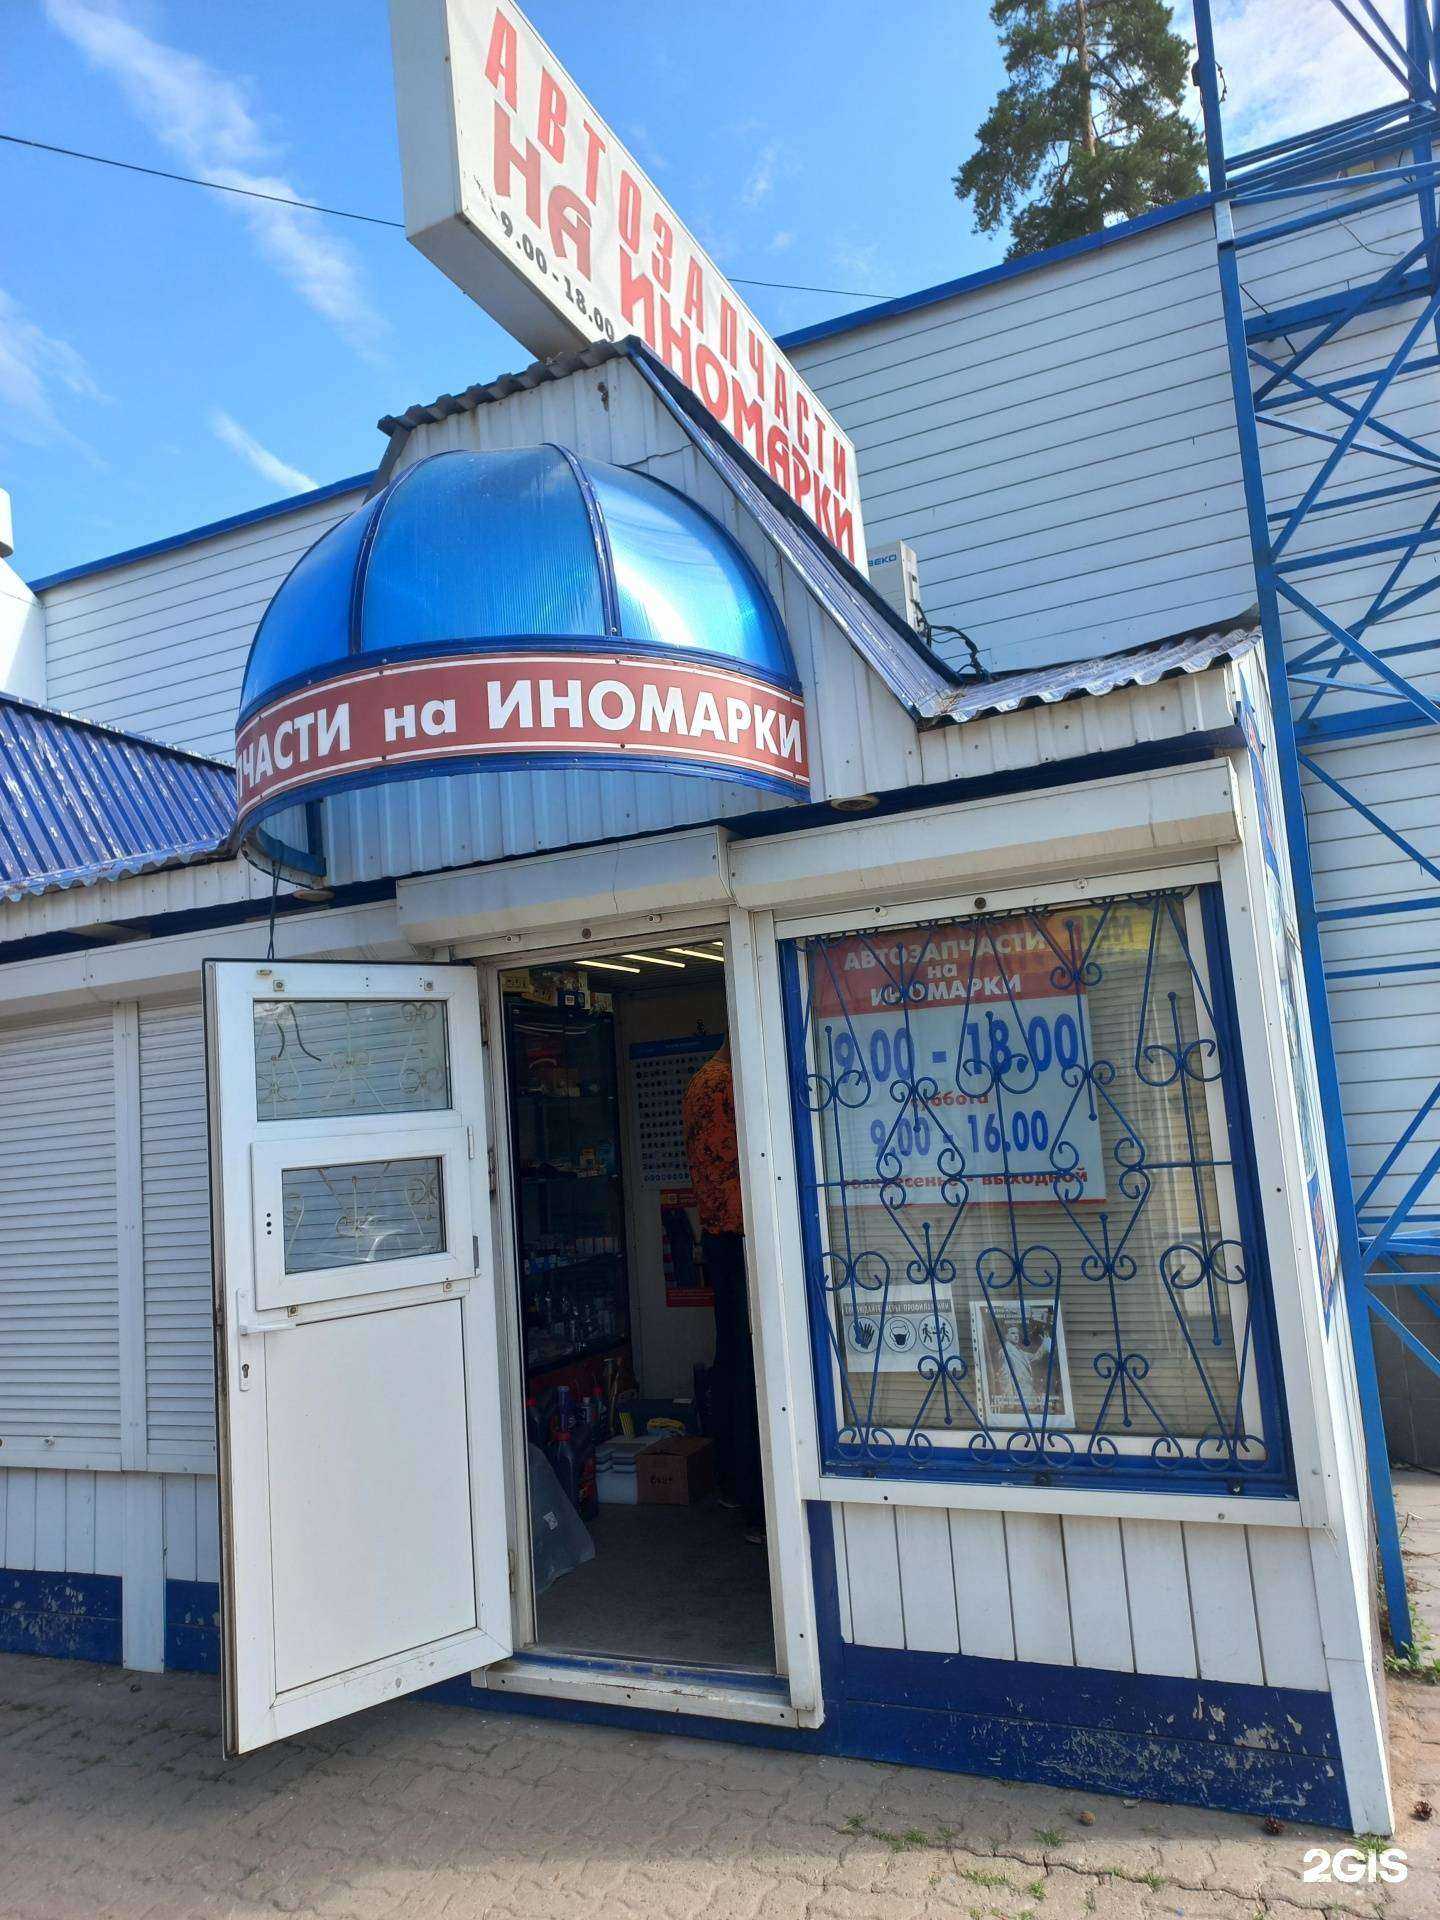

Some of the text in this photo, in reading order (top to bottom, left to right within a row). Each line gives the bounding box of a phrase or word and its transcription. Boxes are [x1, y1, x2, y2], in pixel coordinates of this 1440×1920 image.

[484, 7, 847, 500] АВТОЗАПЧАСТИ
[384, 699, 457, 742] на
[487, 678, 802, 764] ИНОМАРКИ
[844, 931, 1046, 971] АВТОЗАПЧАСТИ
[927, 962, 958, 979] на
[966, 1013, 1079, 1075] 18.00
[967, 1110, 1049, 1153] 16.00
